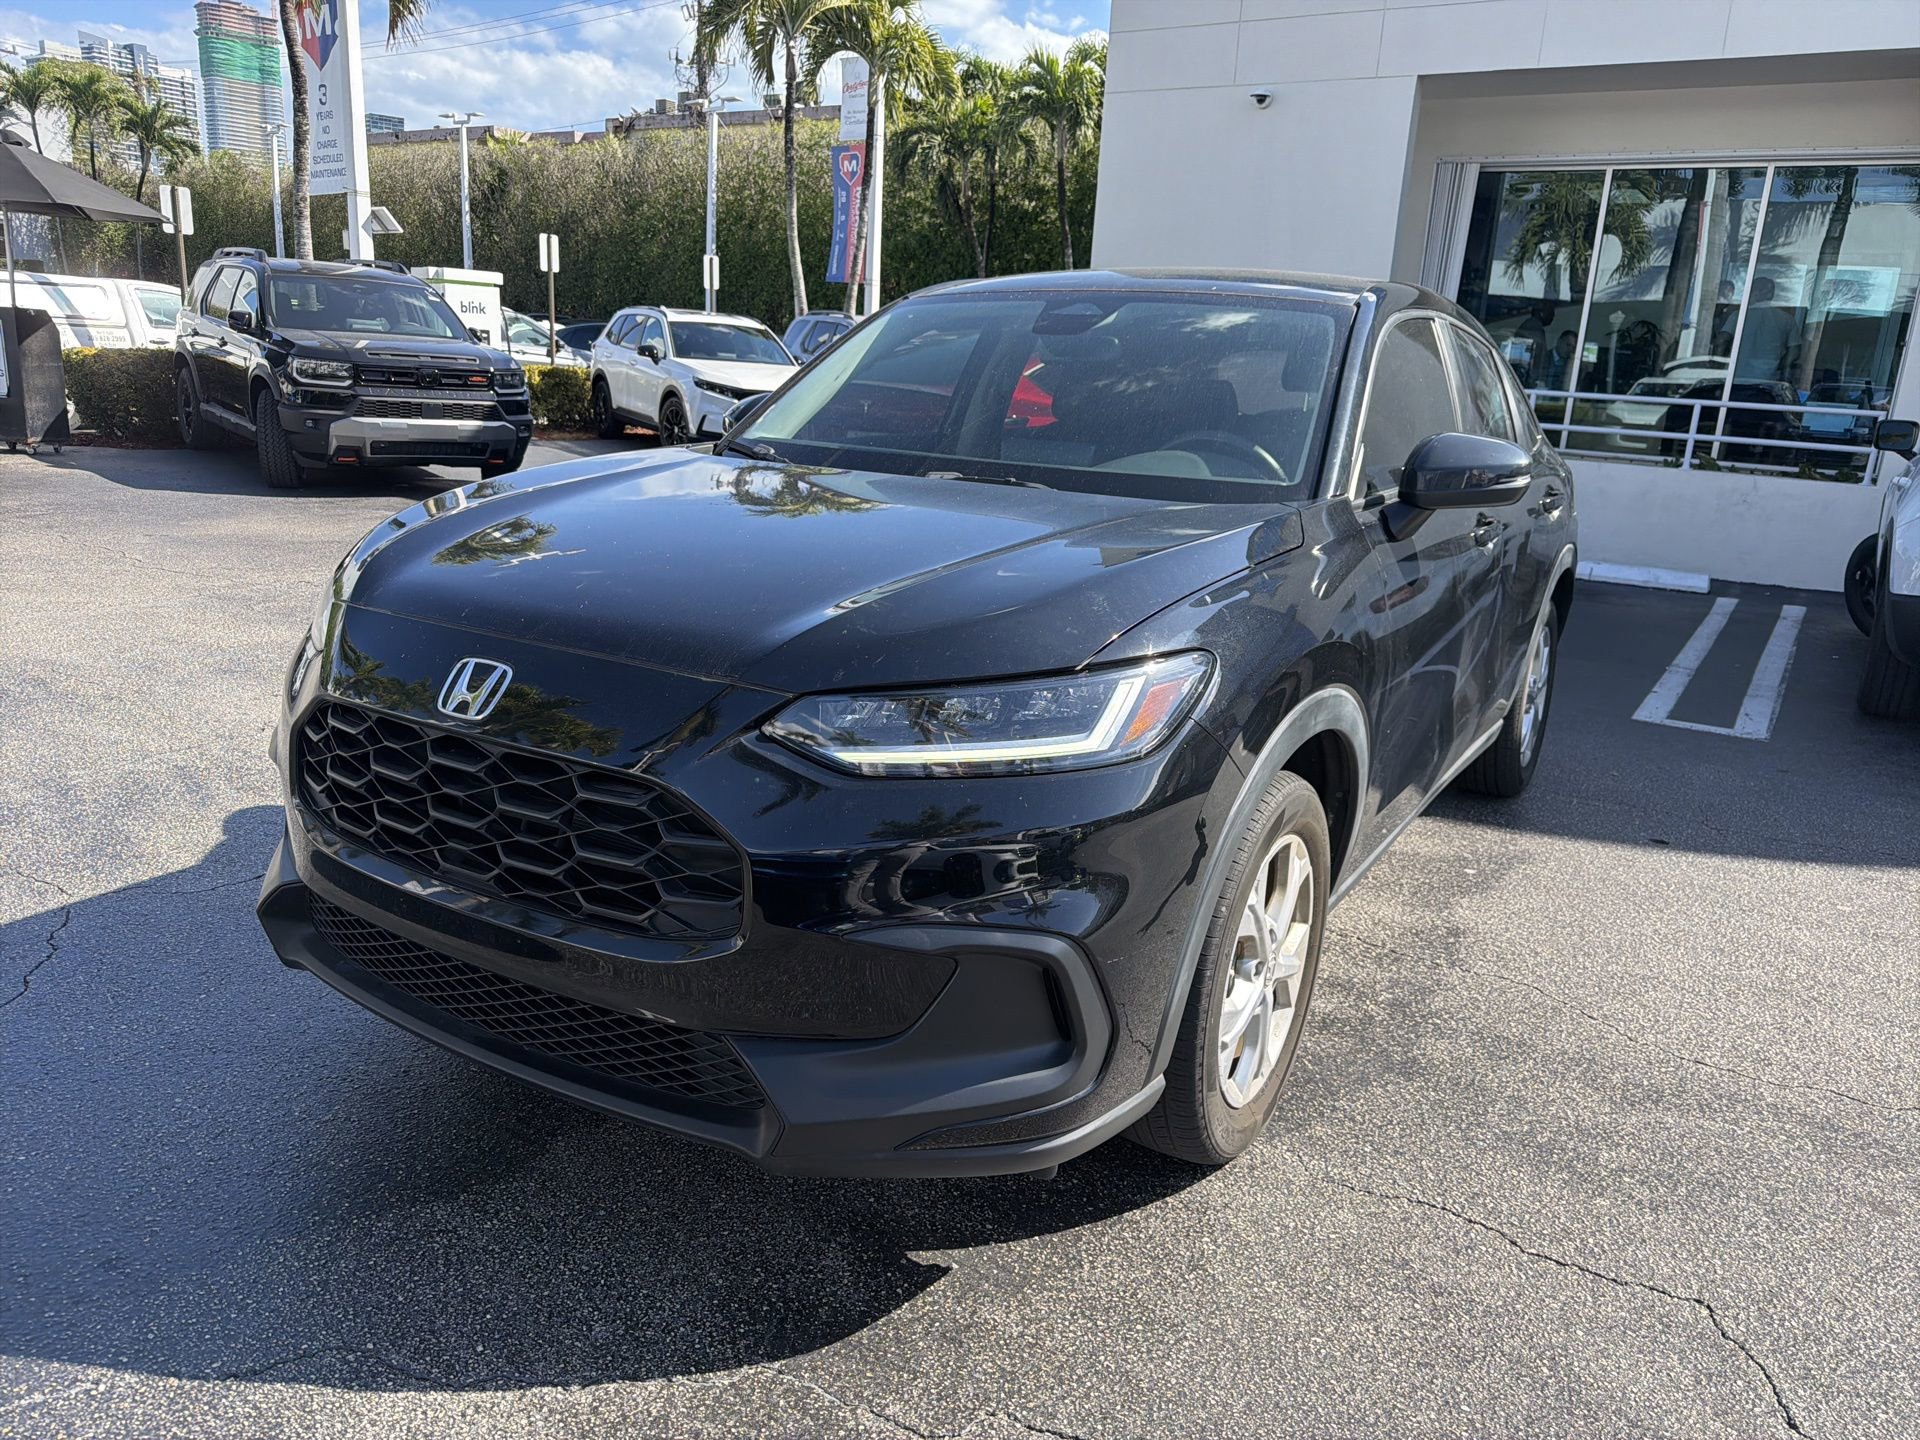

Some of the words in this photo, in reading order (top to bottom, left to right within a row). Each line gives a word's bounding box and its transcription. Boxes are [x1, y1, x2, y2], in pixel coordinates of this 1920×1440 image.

[303, 4, 332, 40] M
[318, 83, 327, 106] 3
[316, 110, 334, 120] YEARS
[322, 125, 331, 135] NO
[316, 139, 338, 150] CHARGE
[312, 153, 344, 165] SCHEDULED
[843, 159, 857, 172] M
[310, 167, 347, 180] MAINTENANCE
[460, 300, 486, 314] blink
